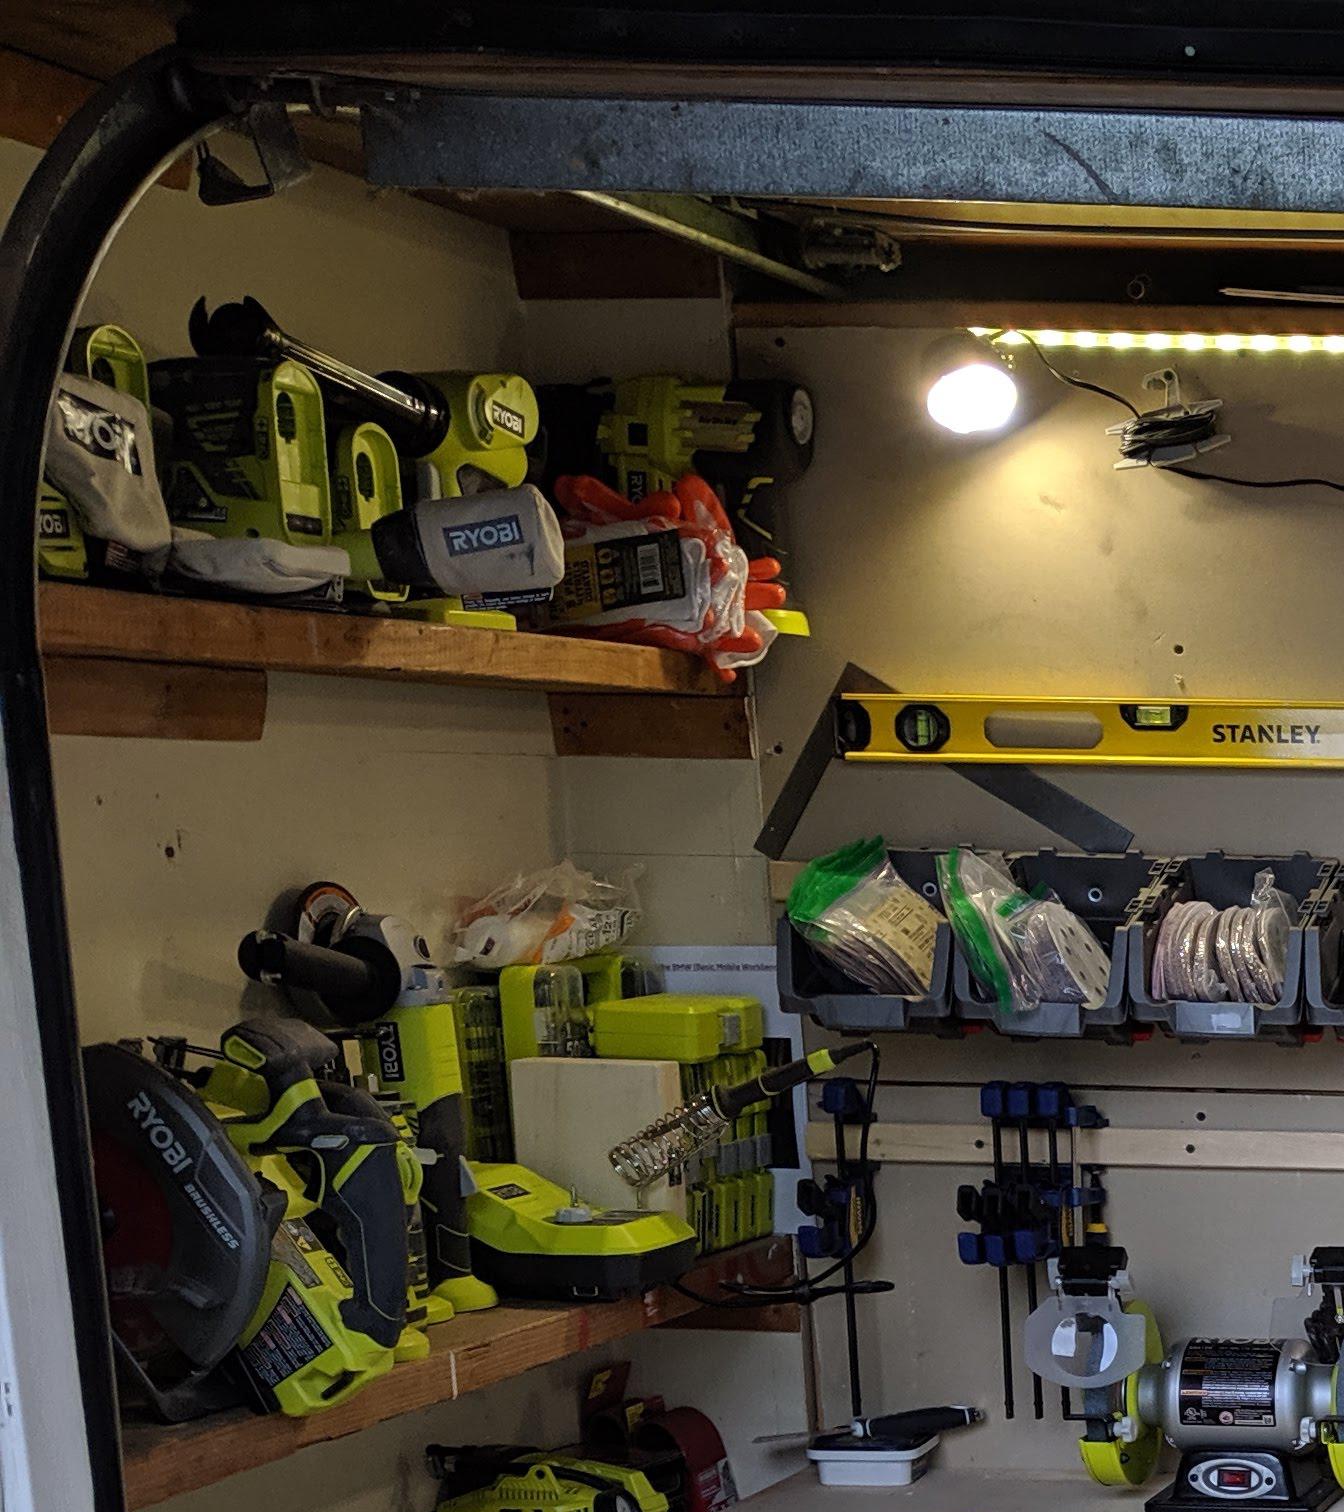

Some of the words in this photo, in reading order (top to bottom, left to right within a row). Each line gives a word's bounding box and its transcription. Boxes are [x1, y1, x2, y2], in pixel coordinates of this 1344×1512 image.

[492, 405, 523, 434] RYOBI
[449, 521, 520, 551] RYOBI
[1212, 724, 1320, 744] STANLEY
[383, 1024, 399, 1078] RYOBI
[127, 1091, 193, 1174] RYOBI
[184, 1183, 240, 1250] BRUSHLESS
